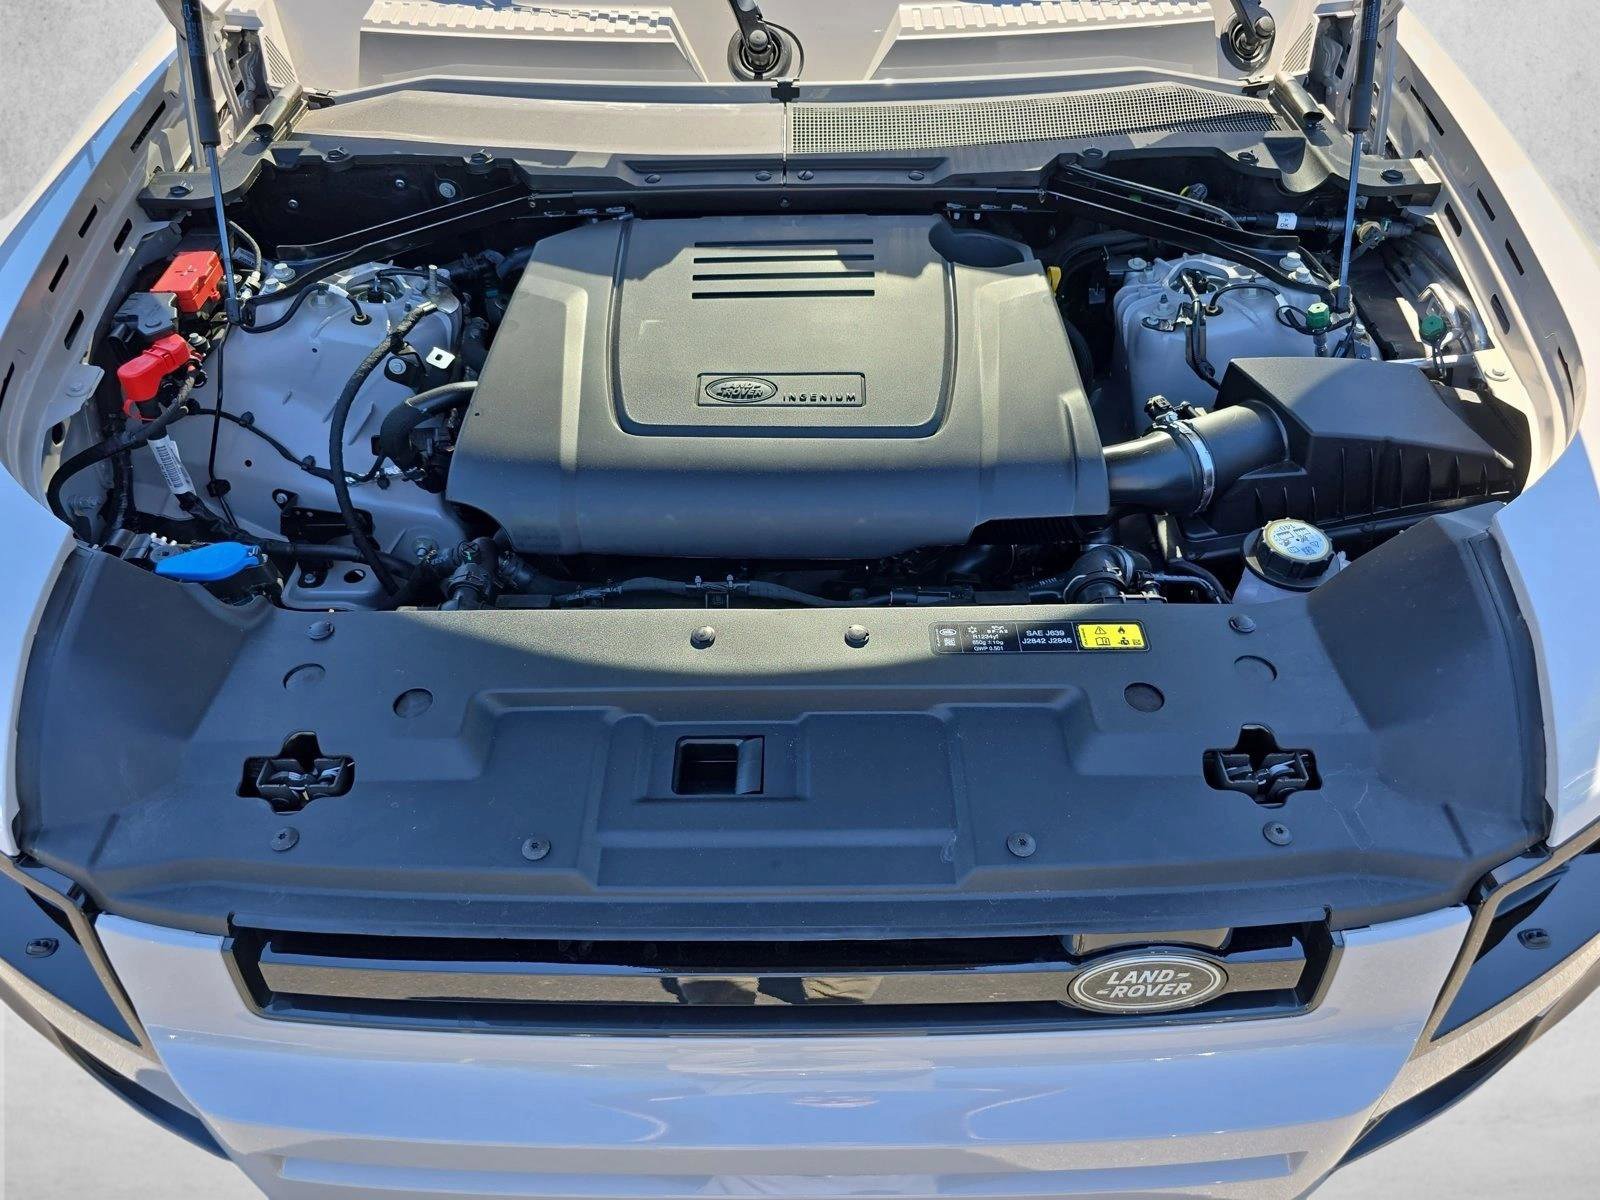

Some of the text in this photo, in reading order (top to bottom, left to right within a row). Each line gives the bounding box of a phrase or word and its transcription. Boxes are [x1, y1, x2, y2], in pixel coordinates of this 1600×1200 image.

[720, 387, 764, 399] ROVER
[782, 392, 857, 402] INGENIUM
[1107, 969, 1175, 985] LAND
[1109, 982, 1192, 998] ROVER
